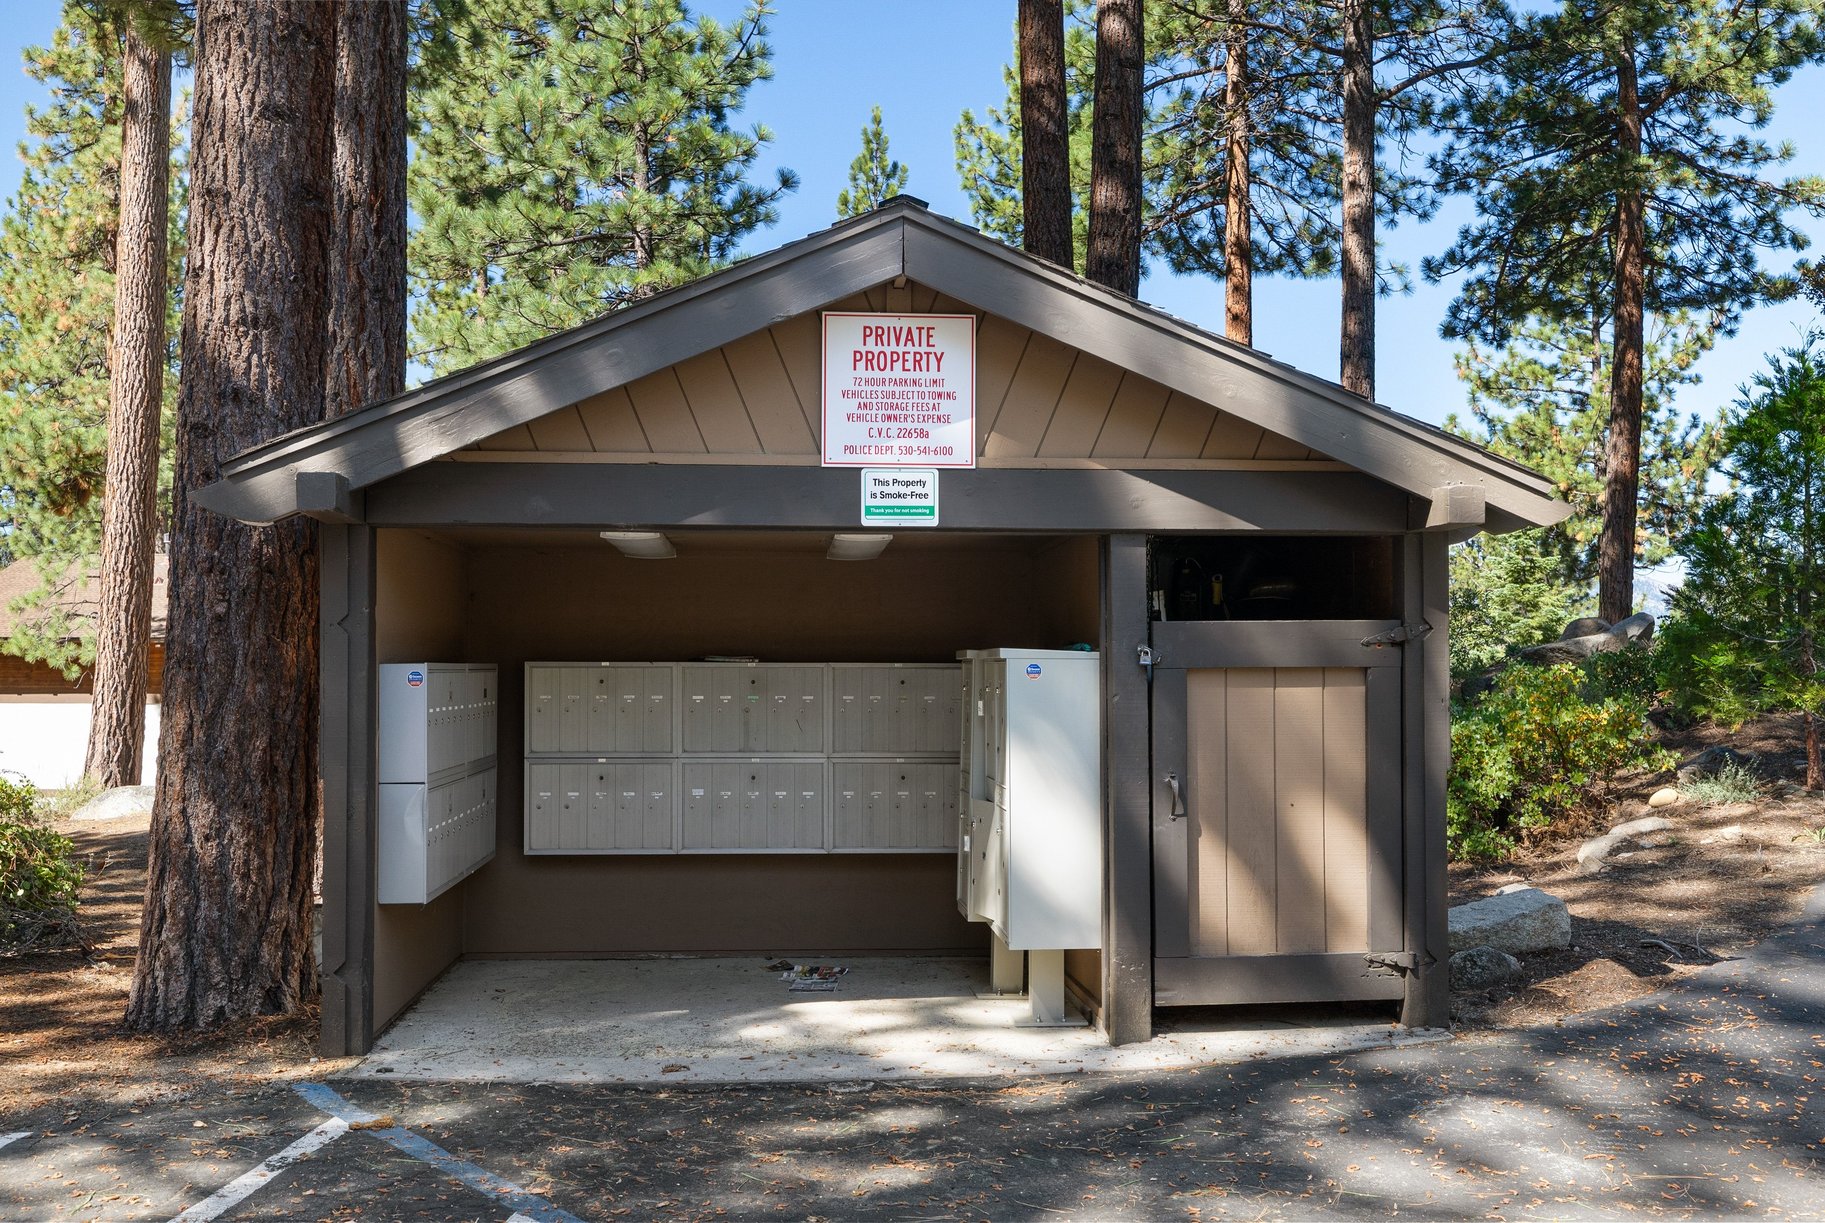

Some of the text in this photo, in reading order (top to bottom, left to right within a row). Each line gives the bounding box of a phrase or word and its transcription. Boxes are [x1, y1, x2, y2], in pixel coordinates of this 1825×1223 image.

[863, 326, 936, 347] PRIVATE
[853, 350, 944, 372] PROPERTY
[853, 377, 945, 388] 72 HOUR PARKING LIMIT
[841, 390, 956, 400] VEHICLES SUBJECT TO TOWING
[857, 402, 940, 412] AND STORAGE FEES AT
[846, 414, 951, 424] VEHICLE OWNER'S EXPENSE
[868, 428, 929, 438] C.V.C. 22658a
[844, 445, 953, 456] POLICE DEPT. 530-541-6100
[873, 478, 926, 488] This Property
[870, 491, 929, 499] is Smoke-Free
